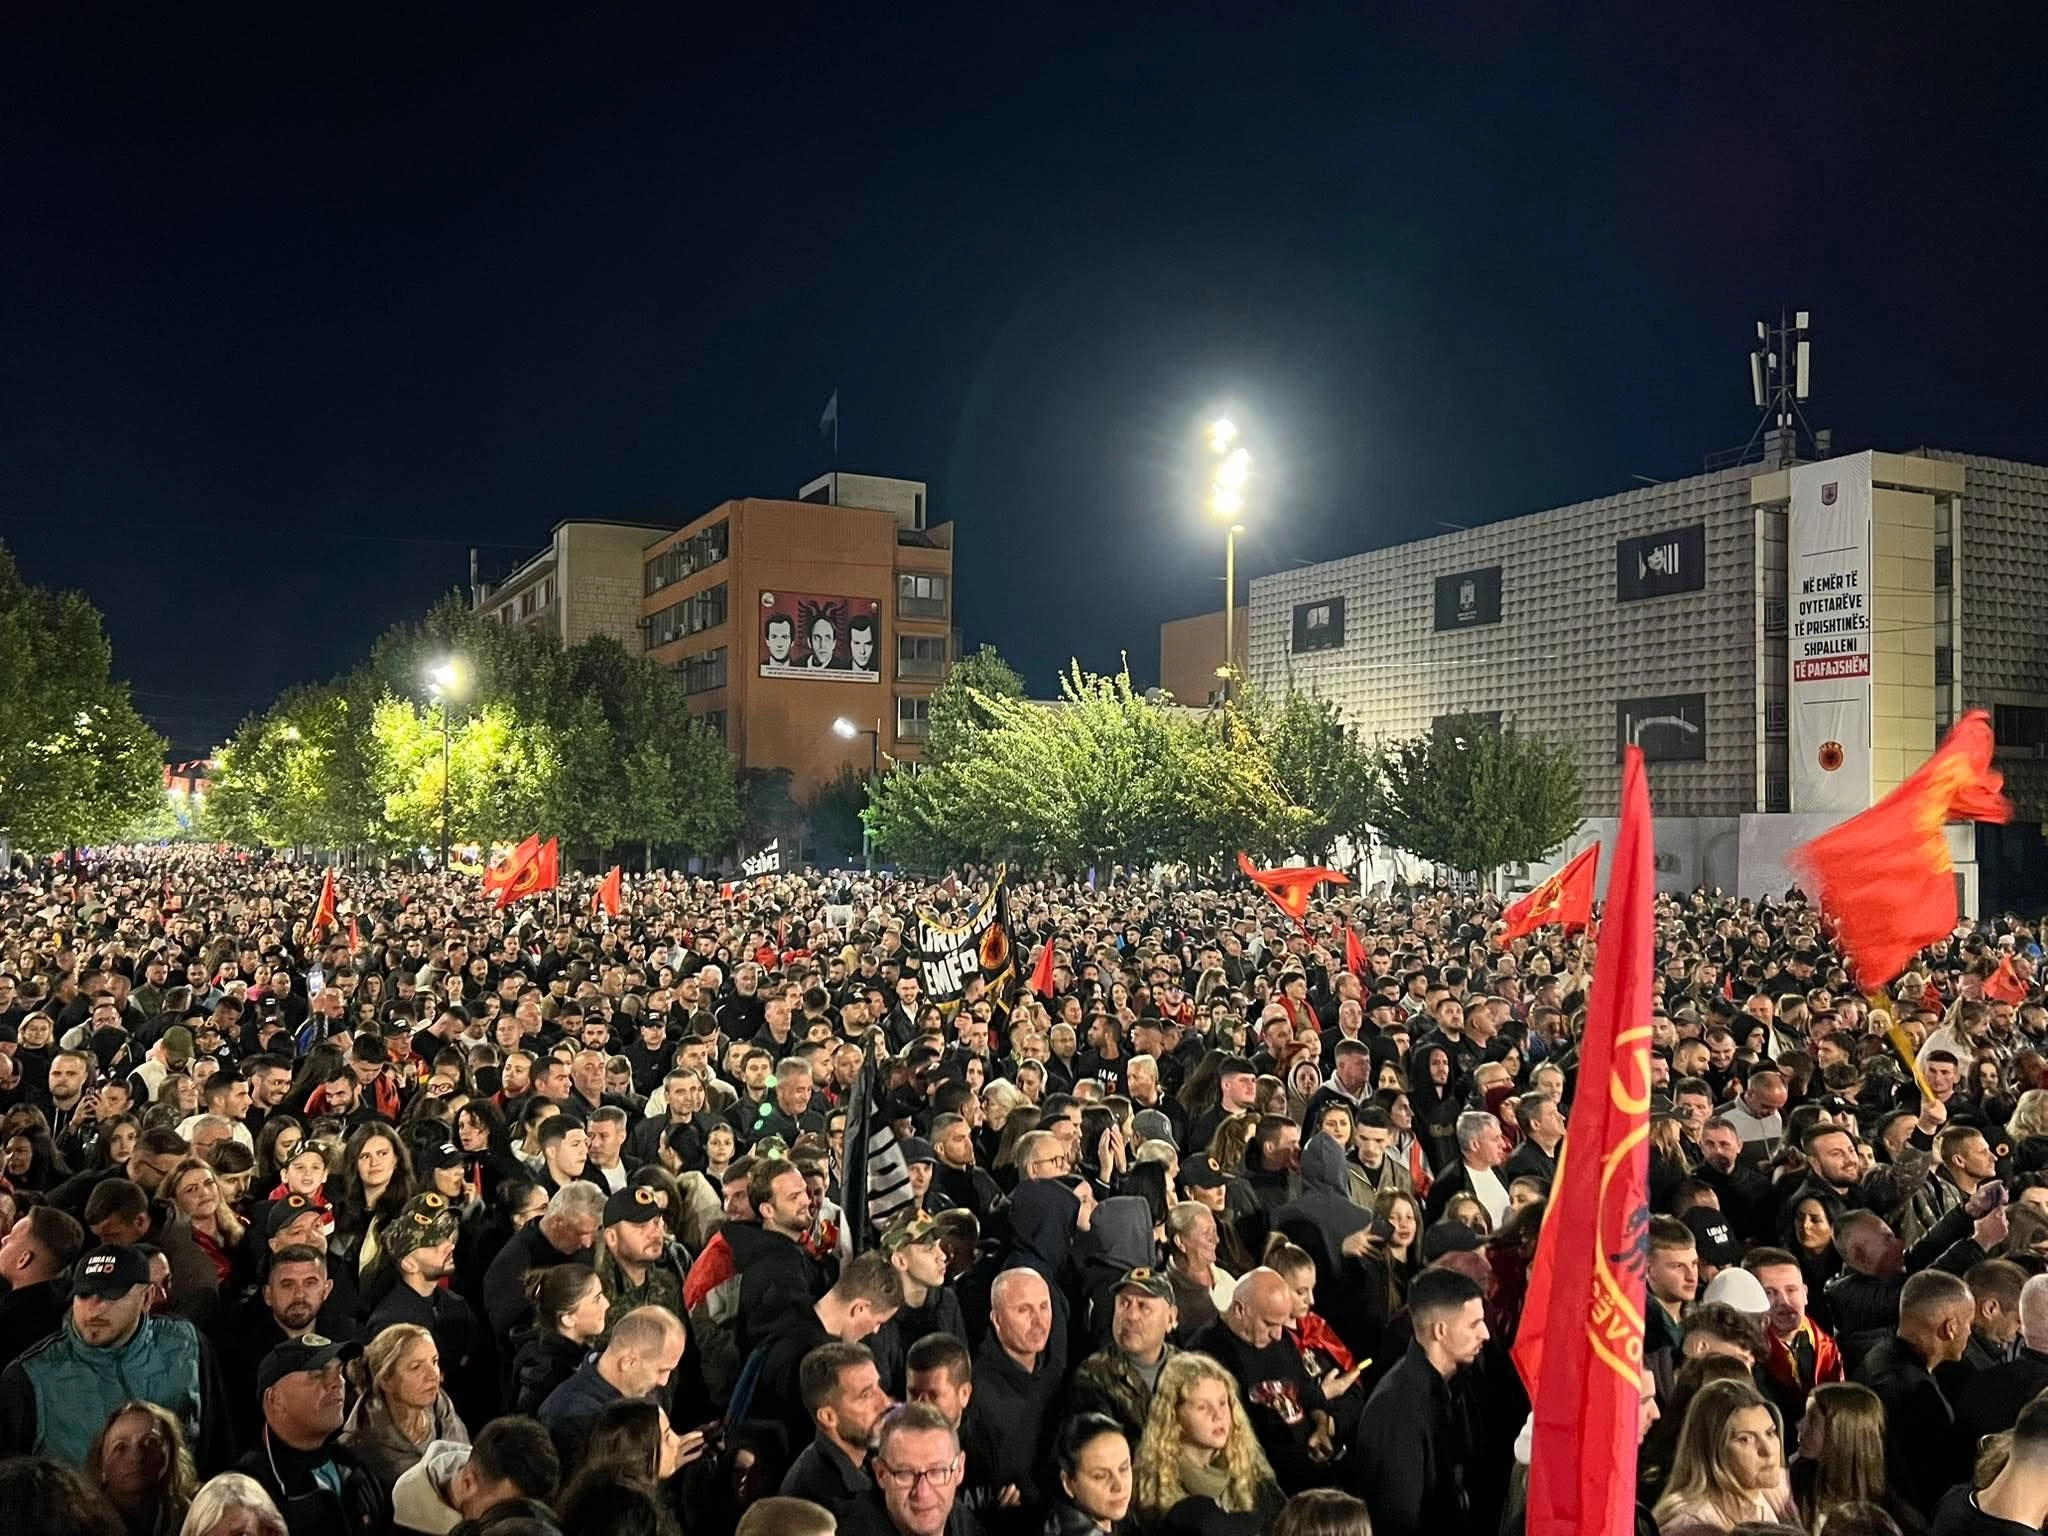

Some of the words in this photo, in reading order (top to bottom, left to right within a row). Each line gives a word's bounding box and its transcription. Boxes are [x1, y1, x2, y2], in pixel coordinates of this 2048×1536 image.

[1803, 576, 1815, 594] NË
[1817, 573, 1843, 592] EMËR
[1845, 570, 1858, 588] TË
[1795, 619, 1805, 637] TË
[1804, 638, 1857, 657] SHPALLENI
[1795, 661, 1807, 679] TË
[1807, 656, 1868, 678] PAFAJSHËM
